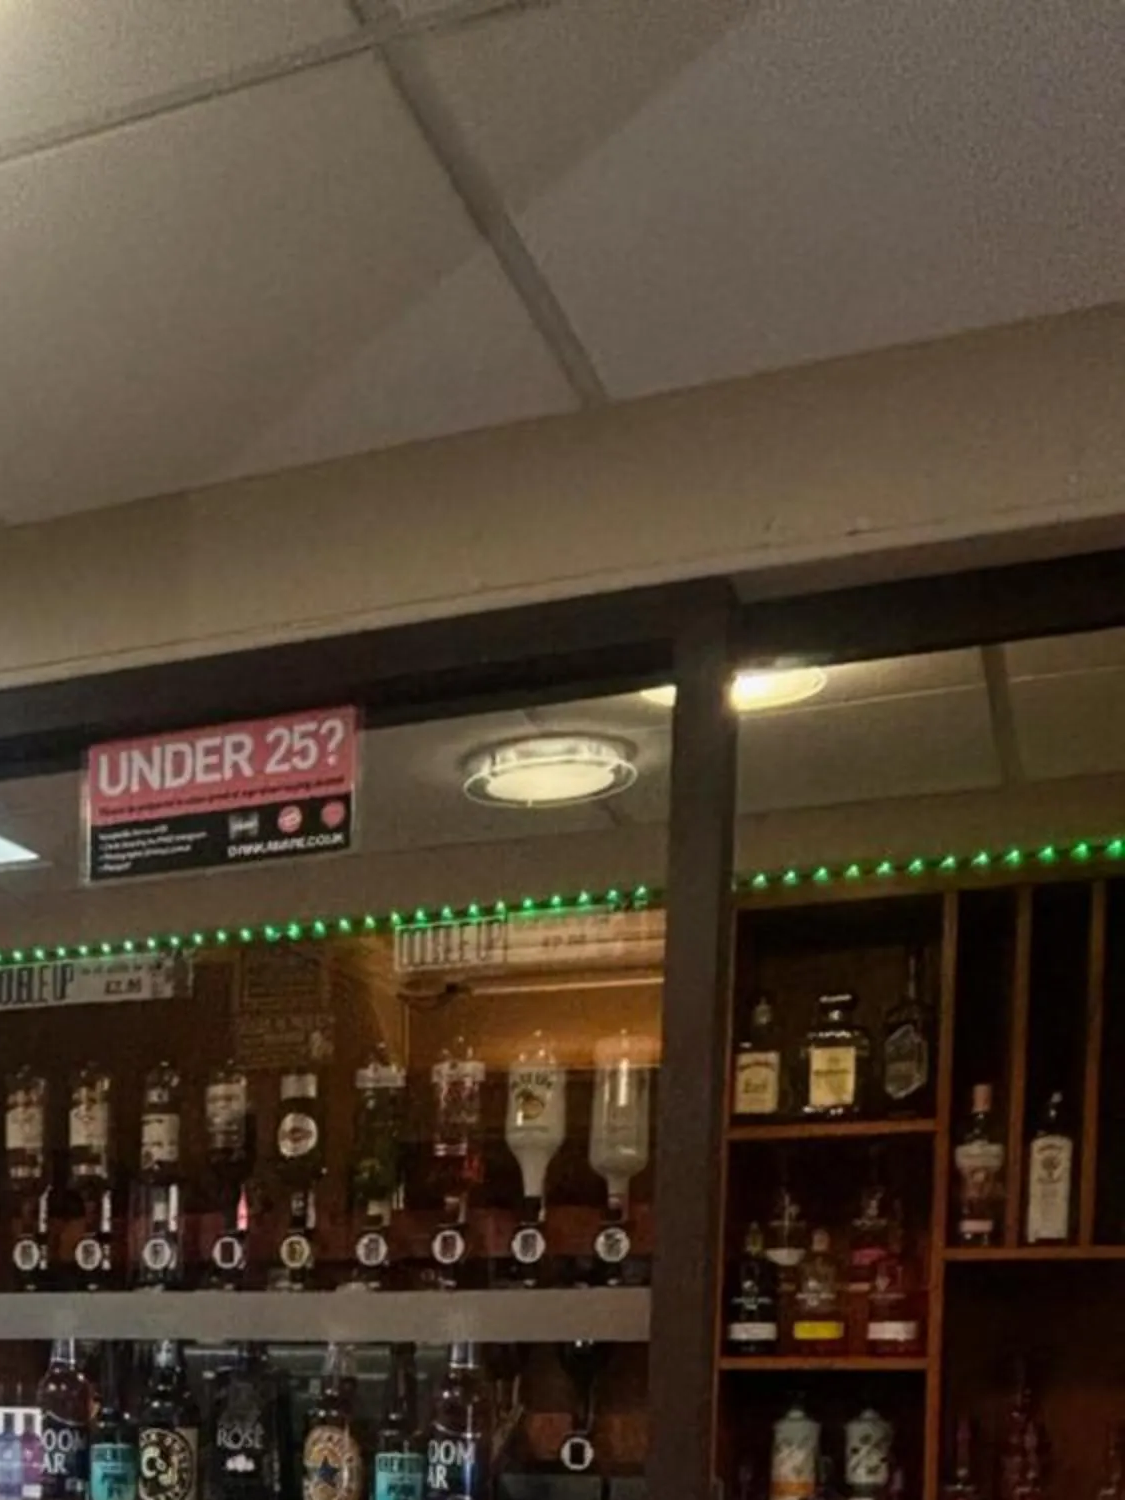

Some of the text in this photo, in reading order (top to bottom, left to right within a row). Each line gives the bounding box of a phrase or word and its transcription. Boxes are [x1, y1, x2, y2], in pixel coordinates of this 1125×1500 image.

[98, 733, 254, 797] UNDER
[264, 719, 345, 775] 25?
[42, 1453, 69, 1475] AR
[427, 1464, 449, 1490] AR
